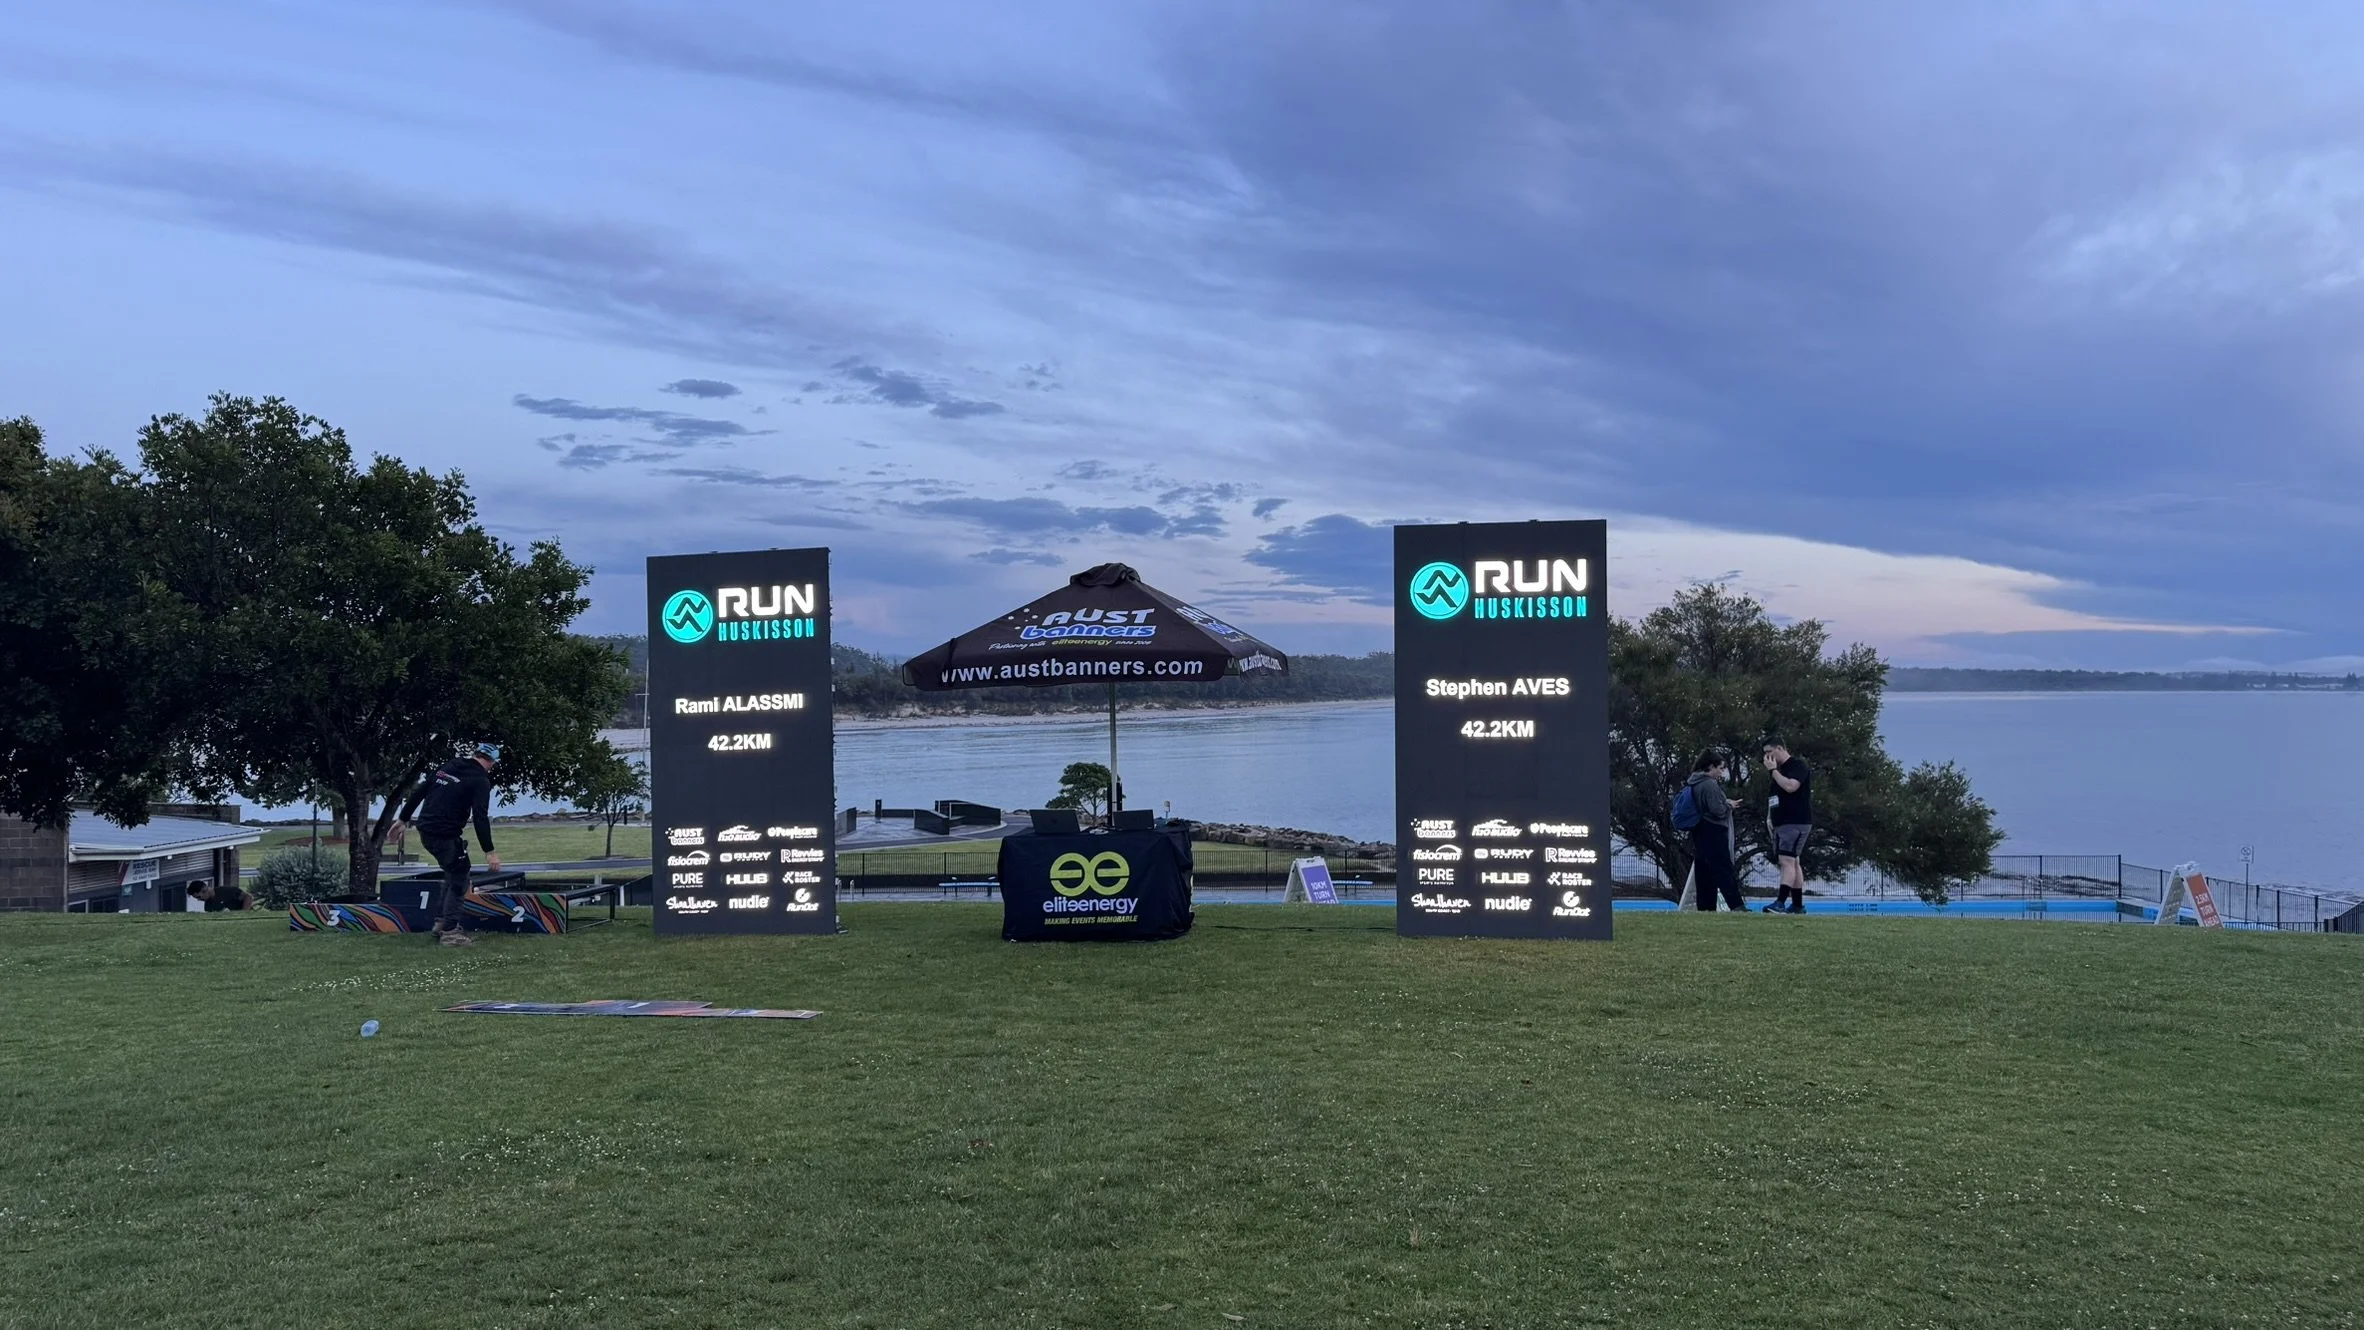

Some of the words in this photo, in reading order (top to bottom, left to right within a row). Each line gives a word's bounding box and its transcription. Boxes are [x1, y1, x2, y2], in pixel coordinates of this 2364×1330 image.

[1475, 558, 1587, 594] RUN
[718, 584, 814, 618] RUN
[1475, 596, 1587, 619] HUSKISSON
[1042, 607, 1155, 625] AUST
[718, 618, 815, 642] HUSKISSON
[1020, 623, 1156, 640] banners
[1426, 678, 1507, 699] Stephen
[1512, 678, 1570, 695] AVES
[675, 697, 719, 714] Rami
[723, 693, 803, 711] ALASSMI
[1461, 720, 1535, 738] 42.2KM
[708, 733, 772, 751] 42.2KM
[672, 872, 704, 885] PURE
[1418, 868, 1454, 880] PURE
[419, 891, 430, 910] 1
[729, 895, 769, 909] nudie
[1042, 896, 1139, 914] eliteenergy
[1484, 896, 1532, 910] nudie
[327, 910, 341, 926] 3
[511, 906, 525, 923] 2
